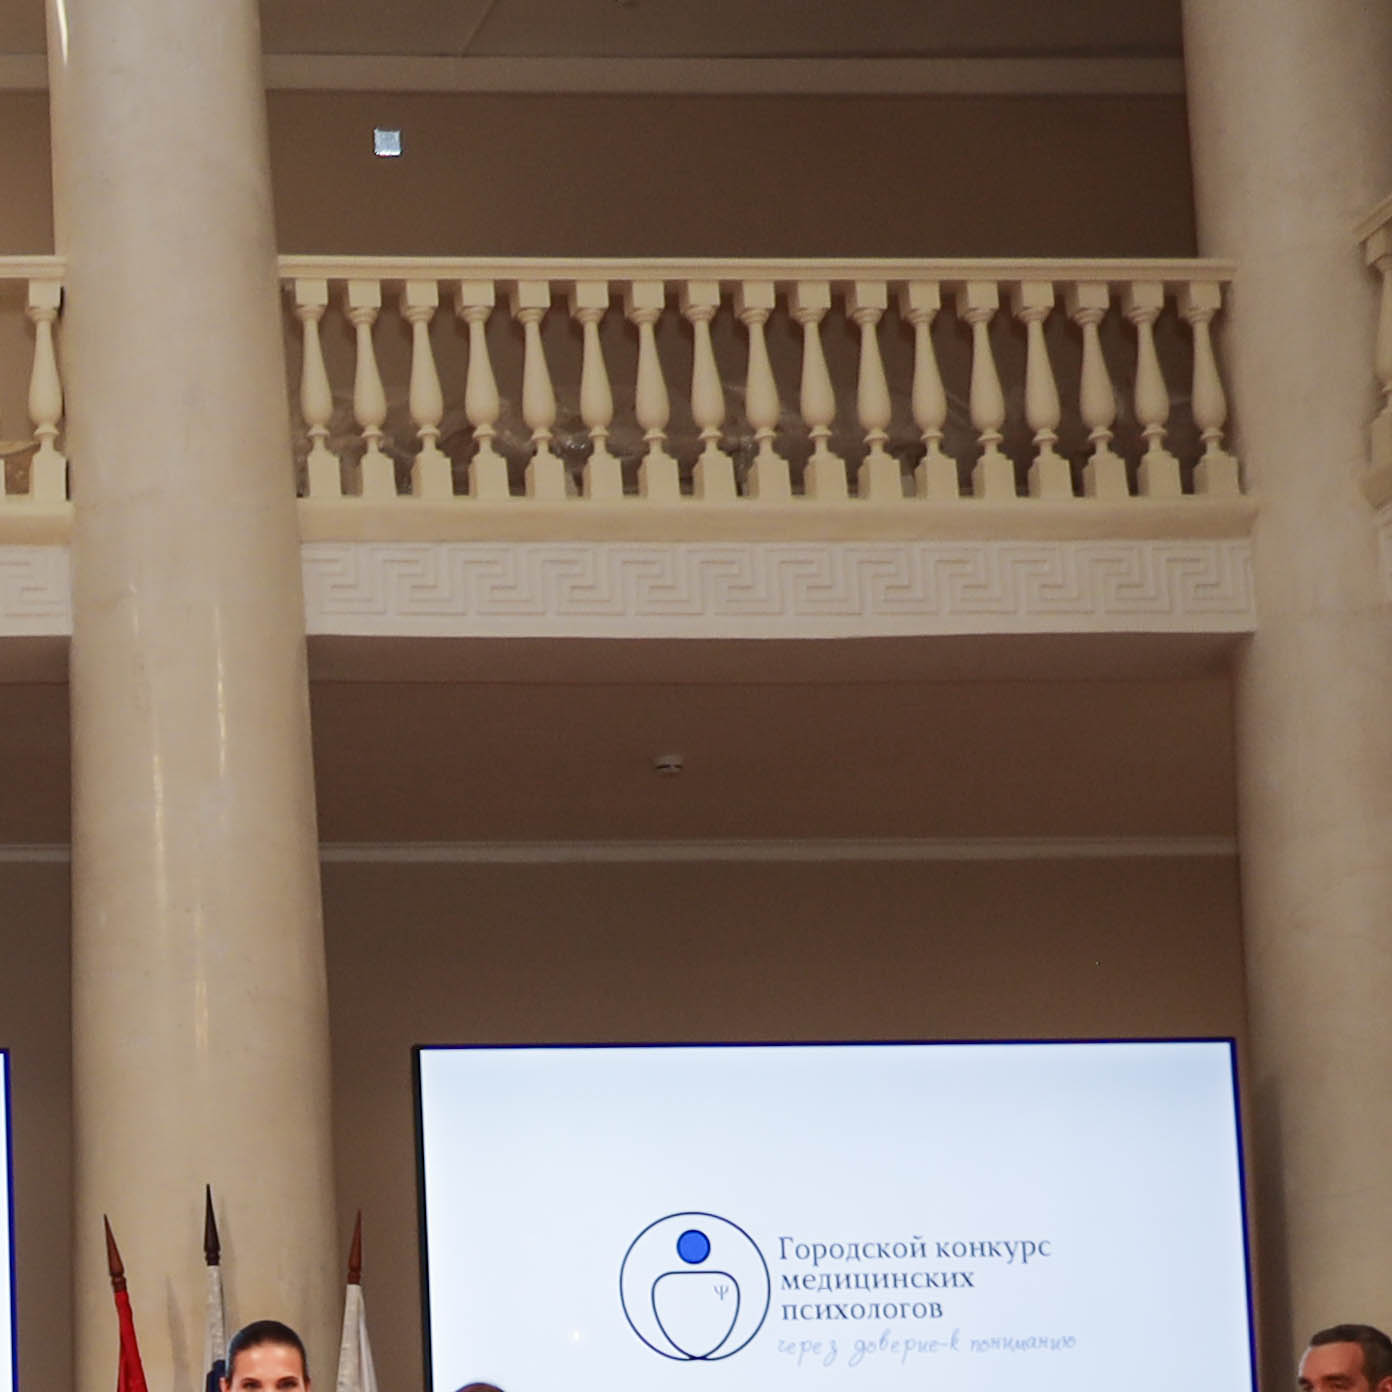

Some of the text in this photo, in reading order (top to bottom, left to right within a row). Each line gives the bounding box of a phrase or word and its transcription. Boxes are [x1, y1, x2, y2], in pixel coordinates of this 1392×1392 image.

[778, 1235, 1052, 1267] Городской конкурс
[780, 1271, 976, 1292] медицинских
[781, 1302, 944, 1321] психологов
